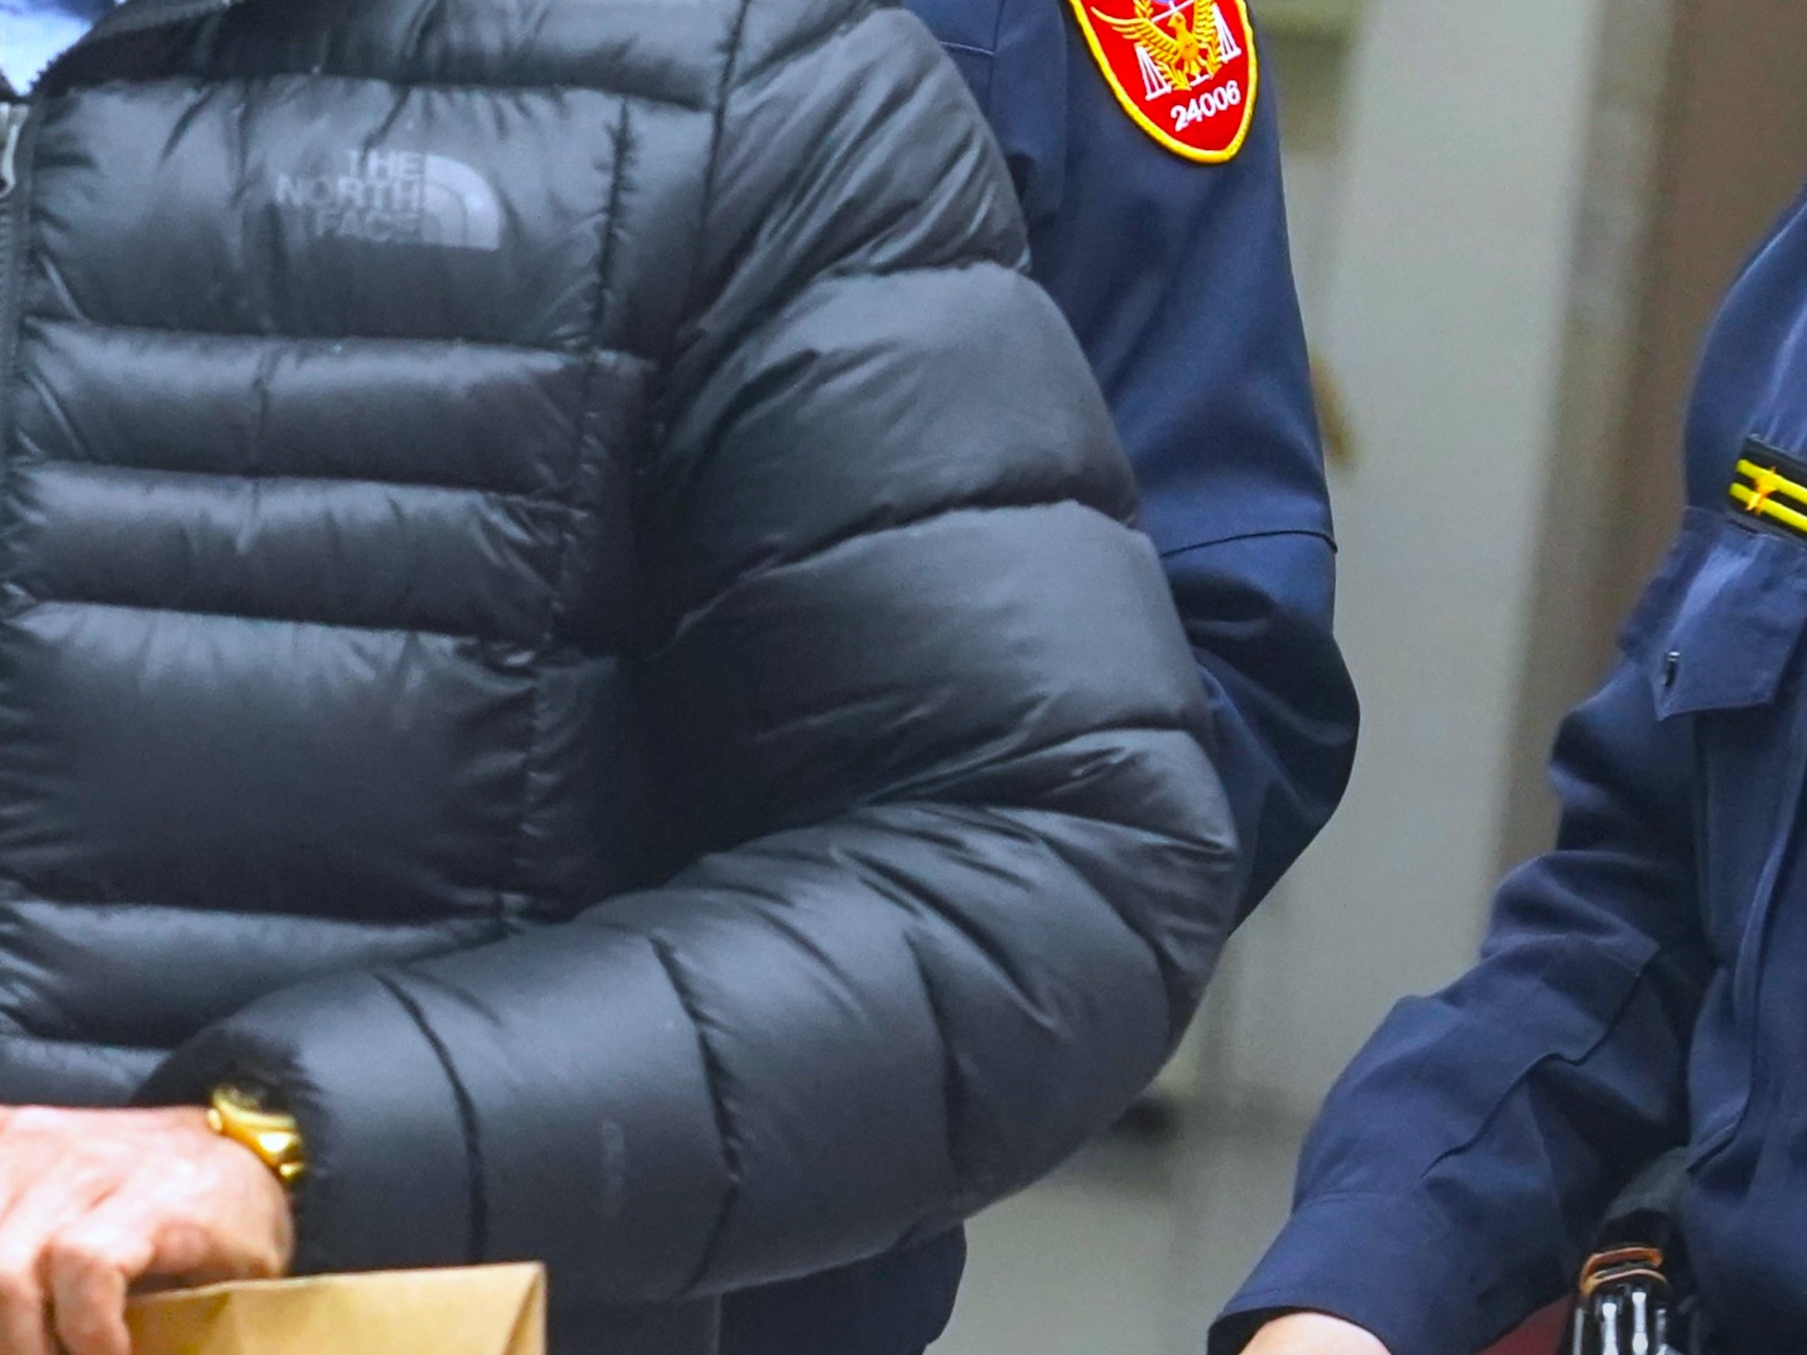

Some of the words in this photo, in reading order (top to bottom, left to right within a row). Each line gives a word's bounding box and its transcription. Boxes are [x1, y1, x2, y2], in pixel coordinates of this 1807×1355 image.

[1170, 79, 1241, 132] 24006
[343, 149, 423, 178] THE
[274, 172, 423, 212] NORTH
